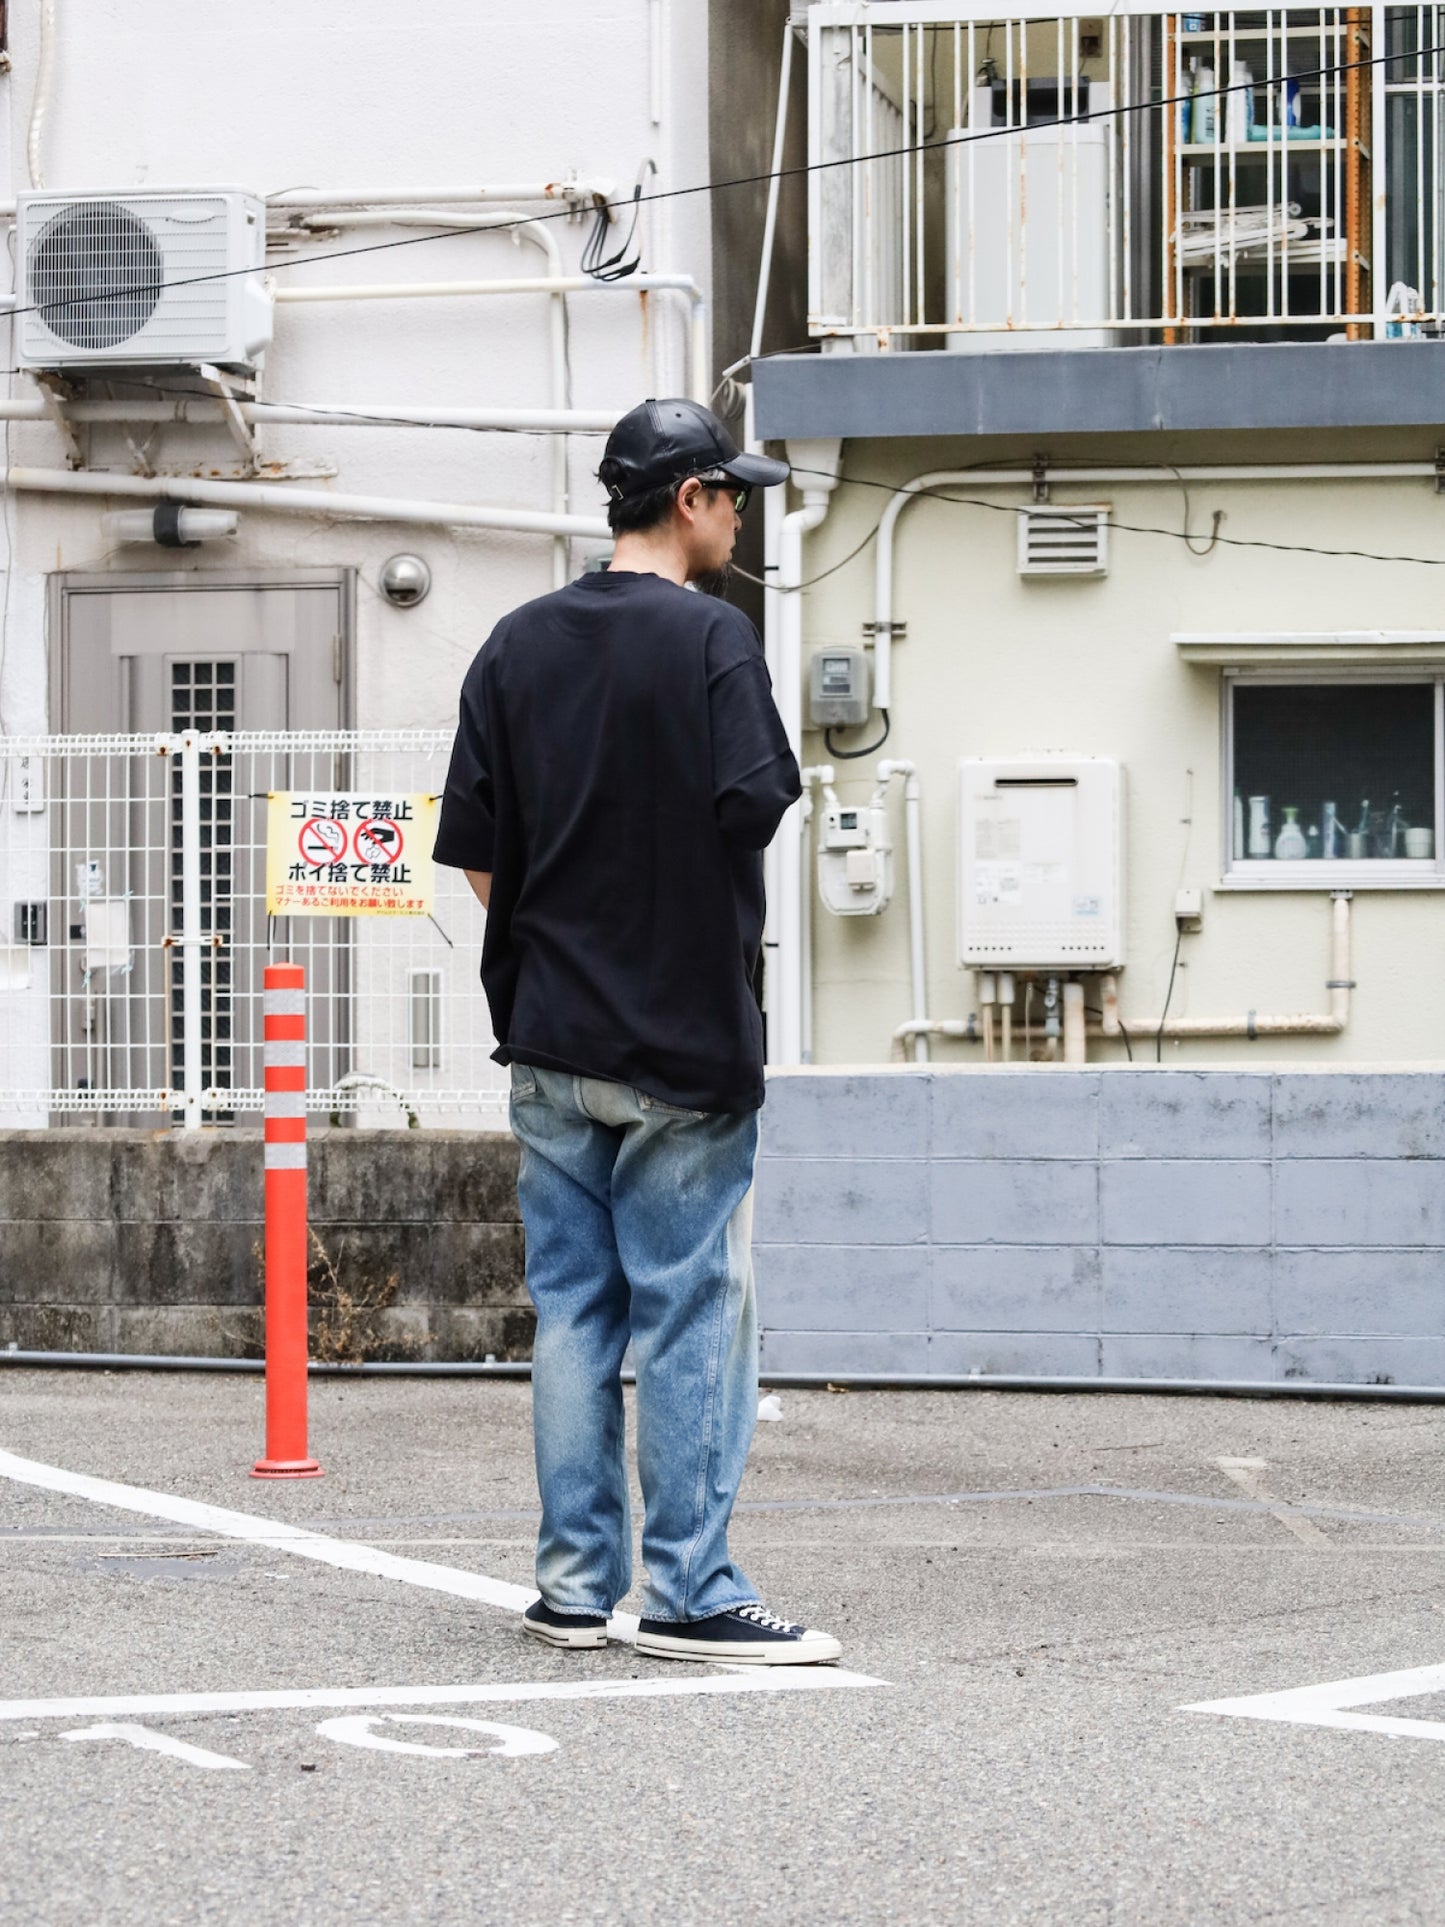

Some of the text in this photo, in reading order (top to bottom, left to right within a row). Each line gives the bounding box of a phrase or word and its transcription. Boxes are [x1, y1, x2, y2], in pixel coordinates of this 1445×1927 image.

[290, 800, 413, 820] ゴミ捨て禁止
[288, 862, 412, 883] ポイ捨て禁止
[276, 885, 404, 897] ゴミを捨てないでください
